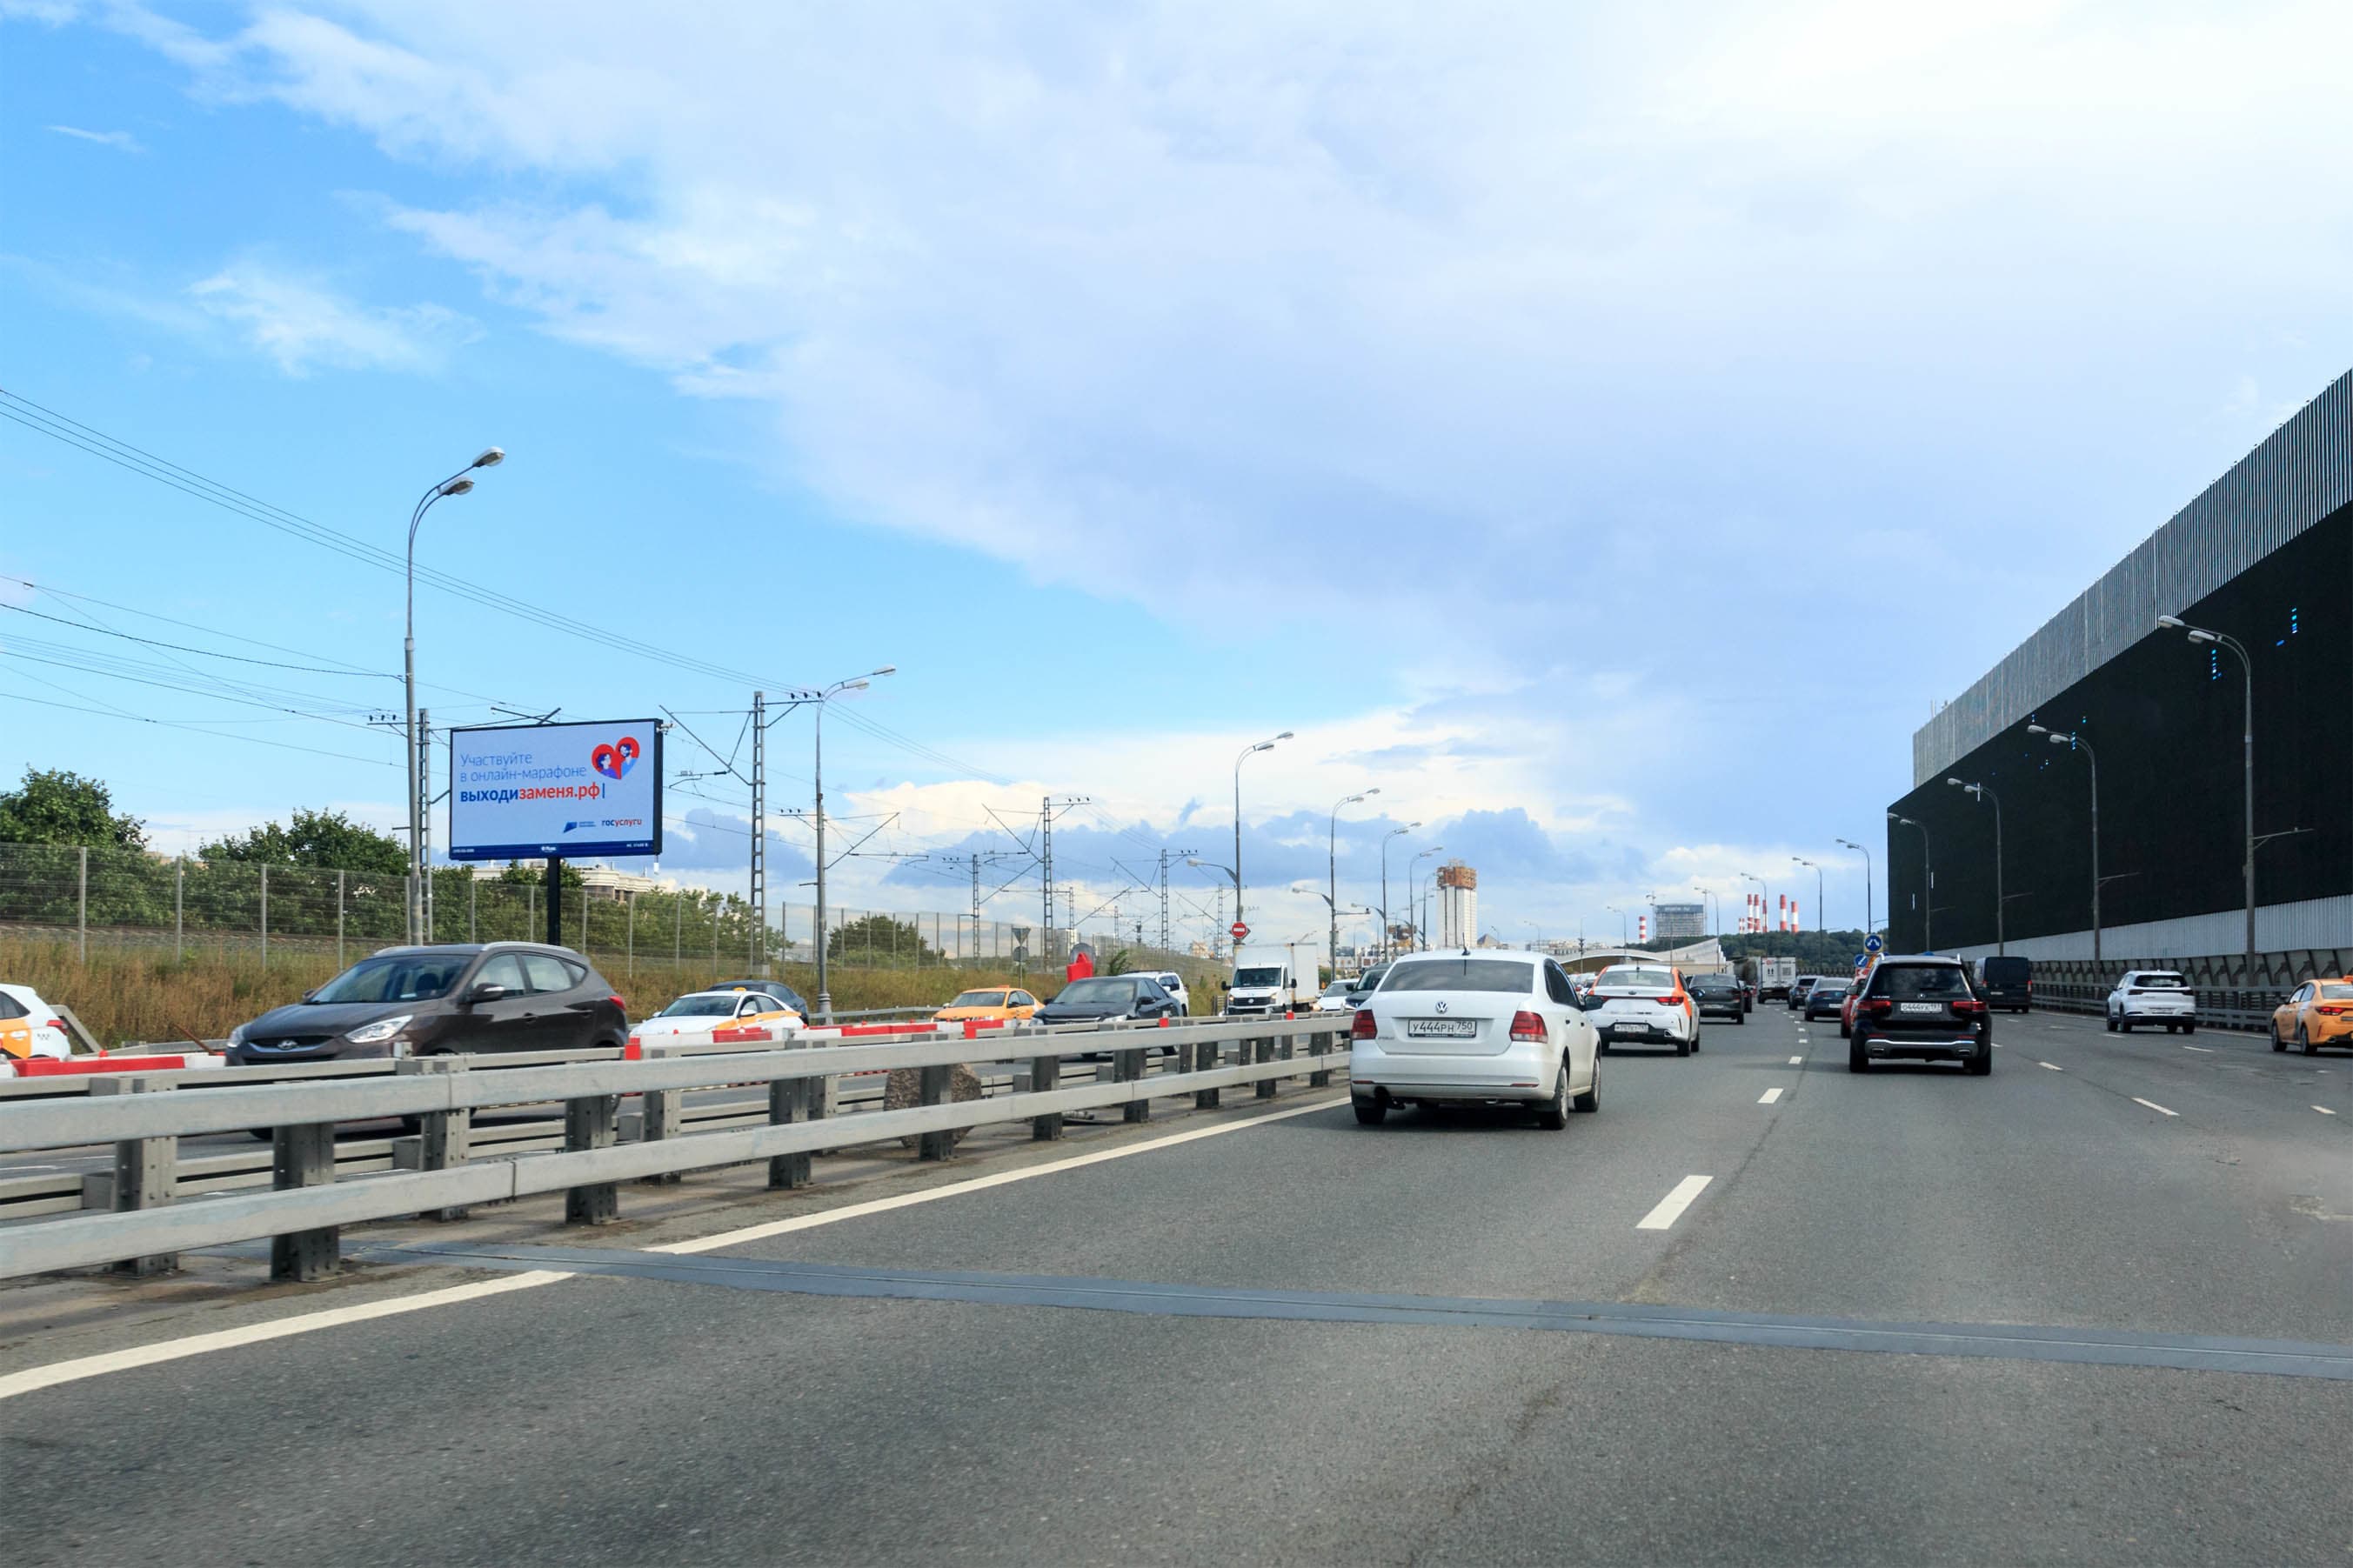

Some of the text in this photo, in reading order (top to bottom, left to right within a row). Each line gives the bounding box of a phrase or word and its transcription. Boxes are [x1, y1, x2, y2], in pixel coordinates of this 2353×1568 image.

[460, 752, 533, 767] Участвуйте
[460, 765, 587, 783] в онлайн-марафоне
[460, 782, 600, 804] выходизаменя.рф
[601, 818, 642, 828] госуслуги
[1455, 1021, 1473, 1031] 750
